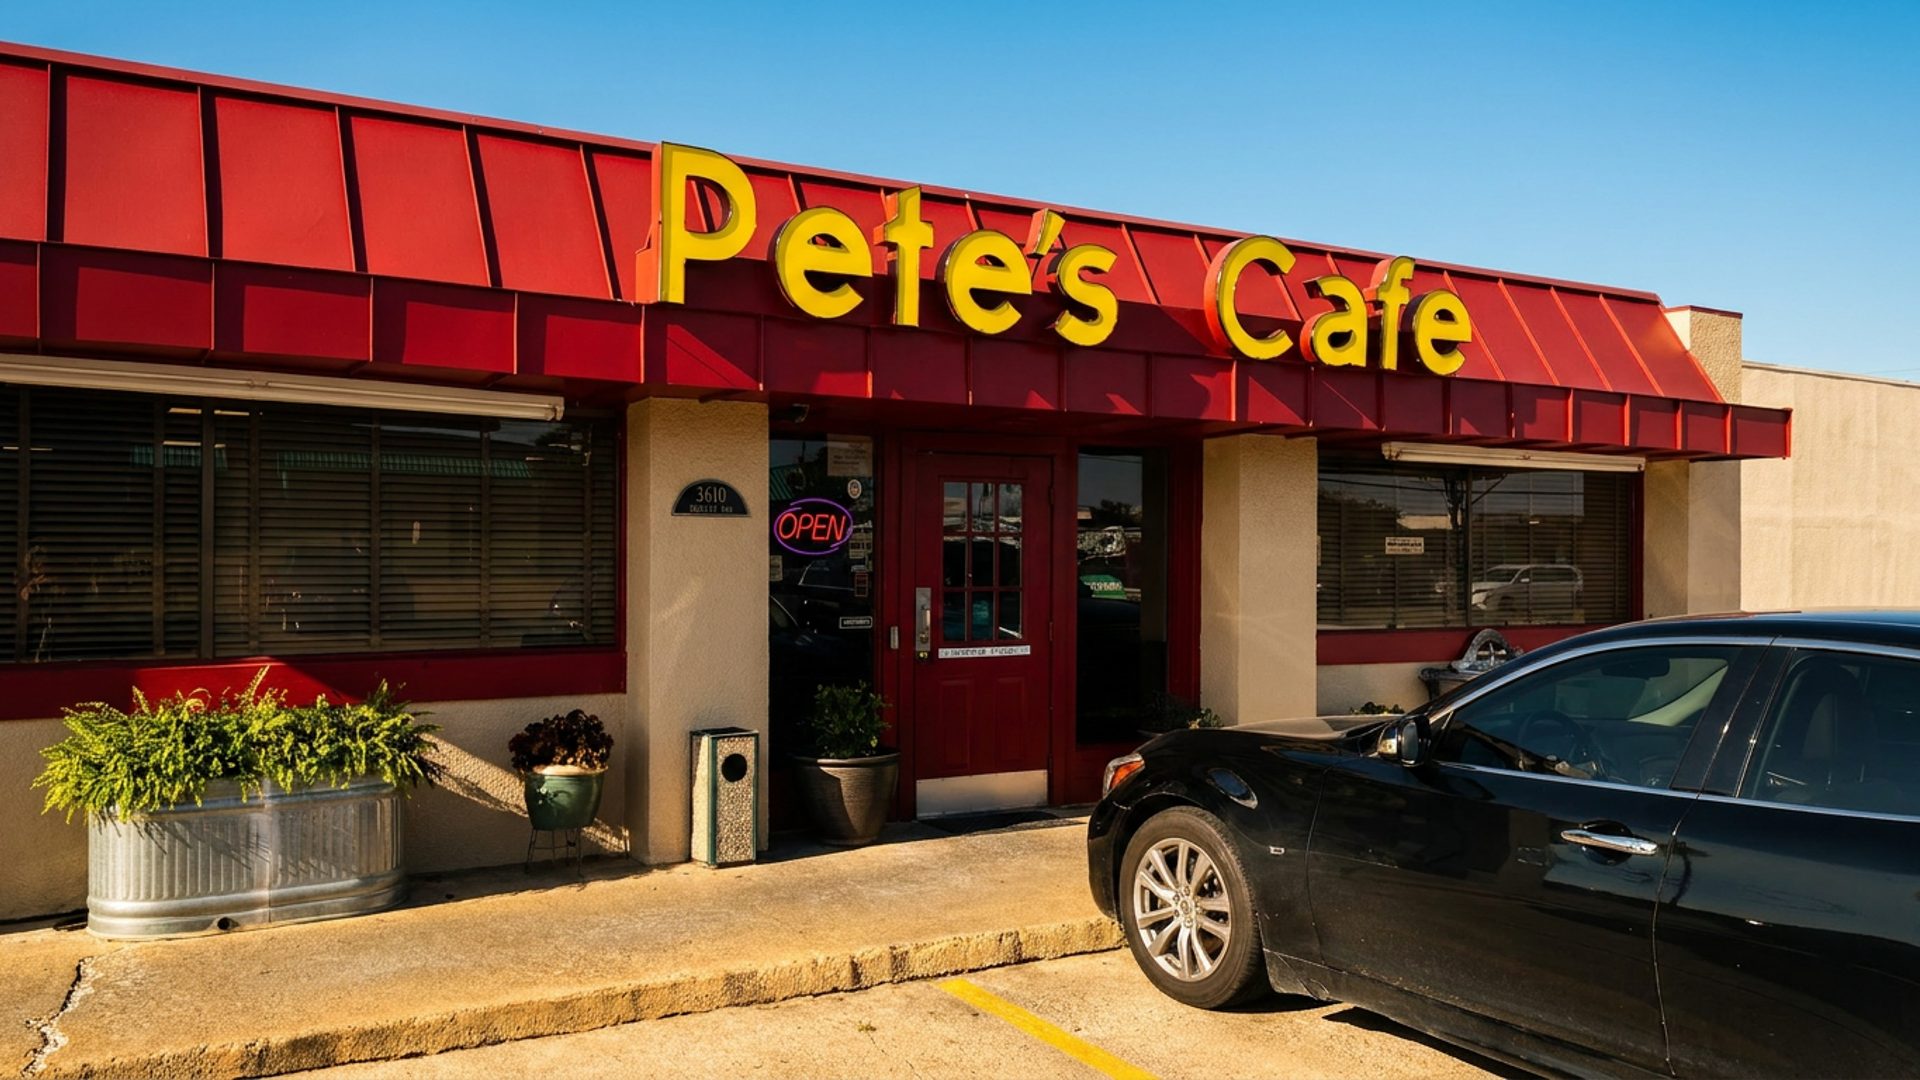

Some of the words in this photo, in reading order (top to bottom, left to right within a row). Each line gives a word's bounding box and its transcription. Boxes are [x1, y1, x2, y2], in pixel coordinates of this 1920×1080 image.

[655, 140, 1118, 347] Pete's
[1208, 234, 1473, 376] Cafe
[695, 486, 727, 503] 3610
[777, 512, 847, 542] OPEN
